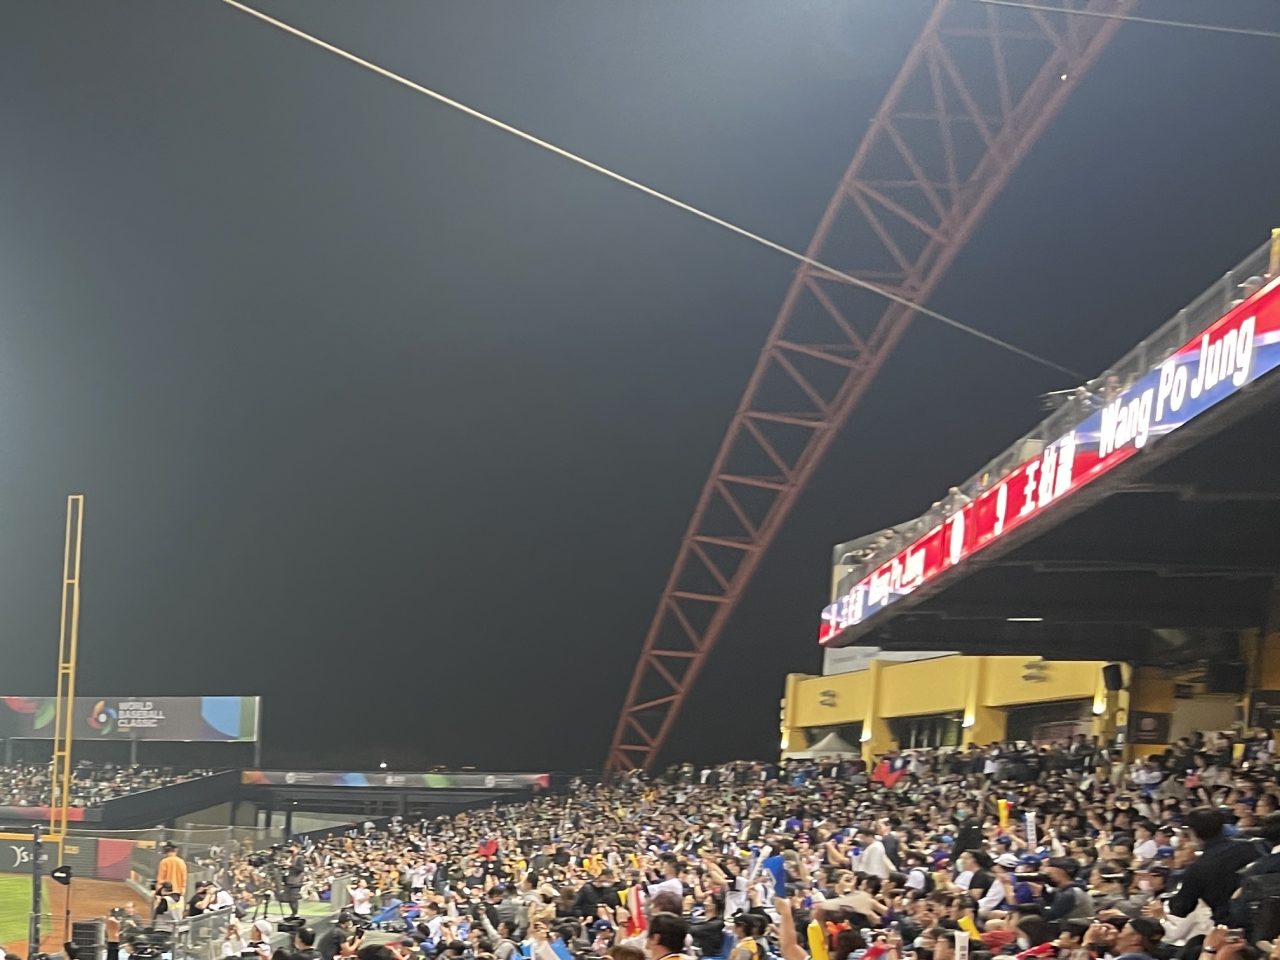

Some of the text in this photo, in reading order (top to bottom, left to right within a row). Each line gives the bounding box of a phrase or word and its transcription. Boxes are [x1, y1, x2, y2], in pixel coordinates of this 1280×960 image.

[1099, 388, 1154, 458] Wang
[1155, 360, 1188, 421] Po
[1191, 315, 1256, 399] Jung
